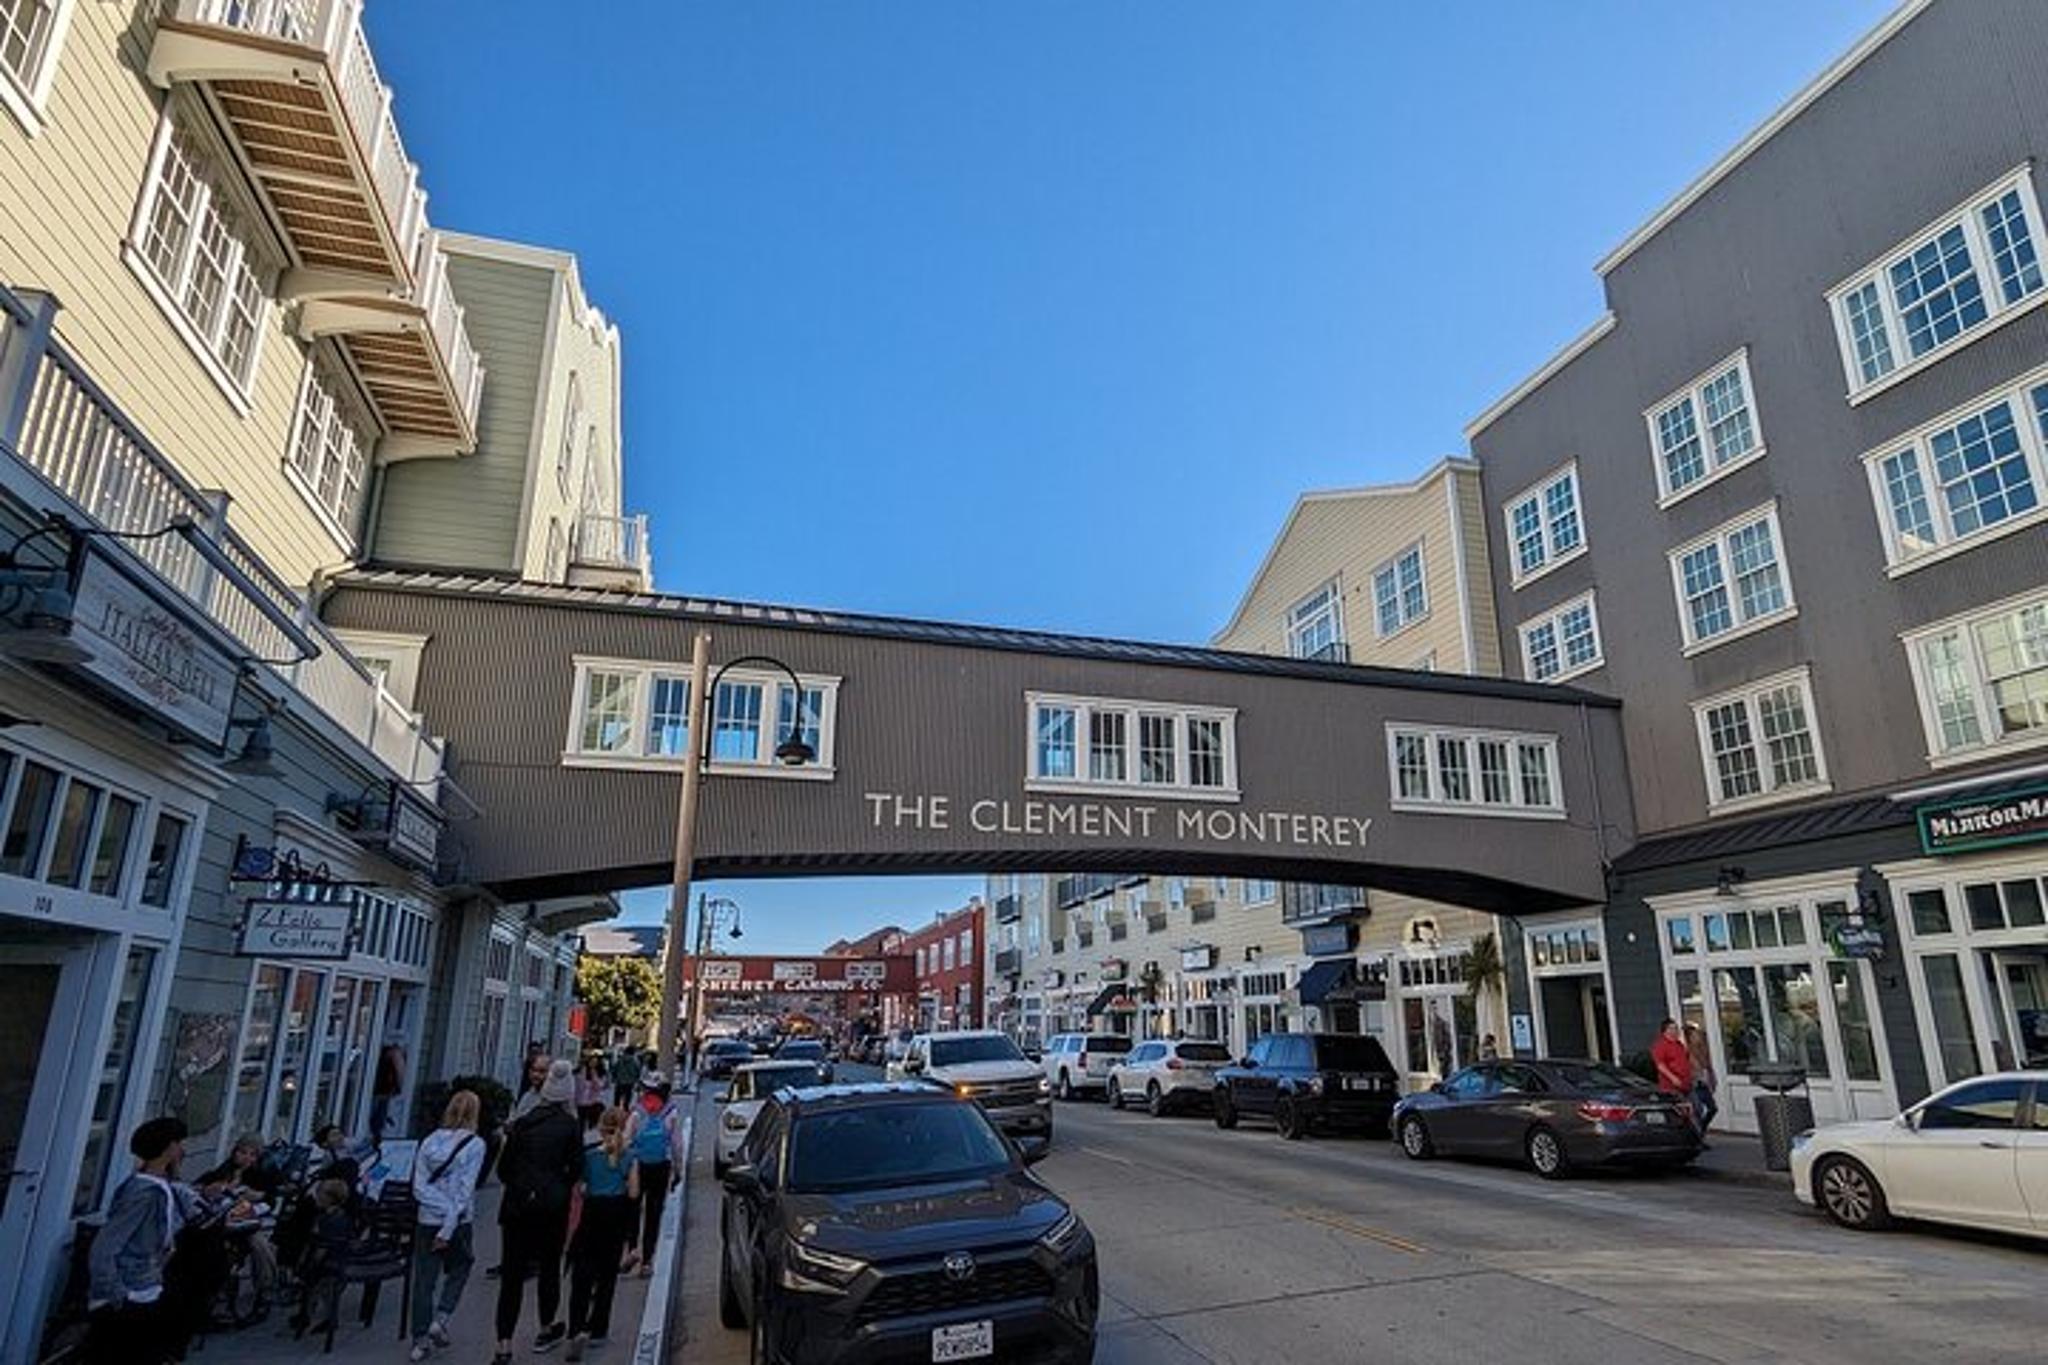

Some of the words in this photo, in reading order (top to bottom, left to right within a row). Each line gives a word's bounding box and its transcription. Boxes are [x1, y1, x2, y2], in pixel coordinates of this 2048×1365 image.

[99, 602, 174, 675] ITALIAN
[179, 658, 216, 706] DELI
[865, 793, 949, 830] THE
[970, 800, 1157, 839] CLEMENT
[1176, 807, 1373, 847] MONTEREY
[270, 929, 338, 951] Gallery
